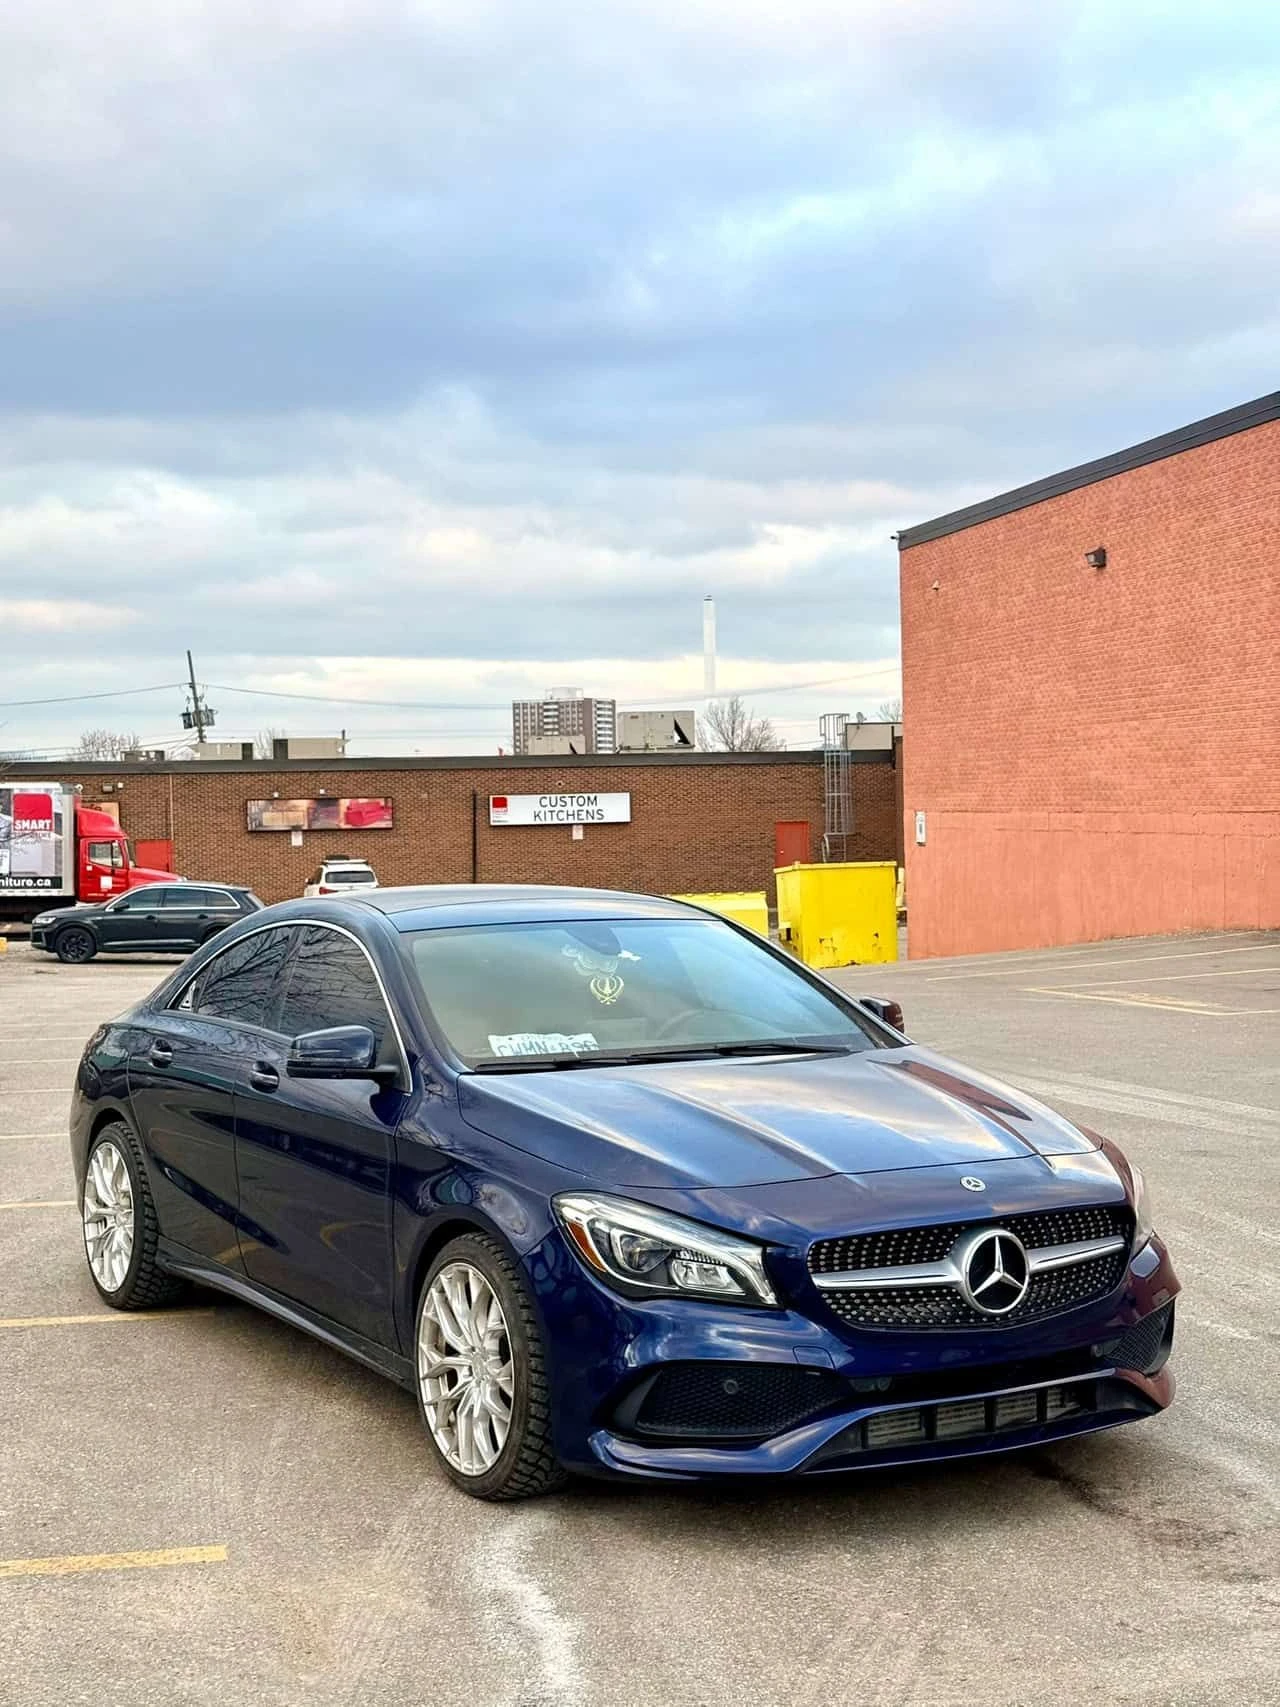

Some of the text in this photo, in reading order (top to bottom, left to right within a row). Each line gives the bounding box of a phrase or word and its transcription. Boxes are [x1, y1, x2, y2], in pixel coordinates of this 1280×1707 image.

[539, 795, 598, 808] CUSTOM
[533, 809, 605, 822] KITCHENS
[14, 819, 52, 831] SMART
